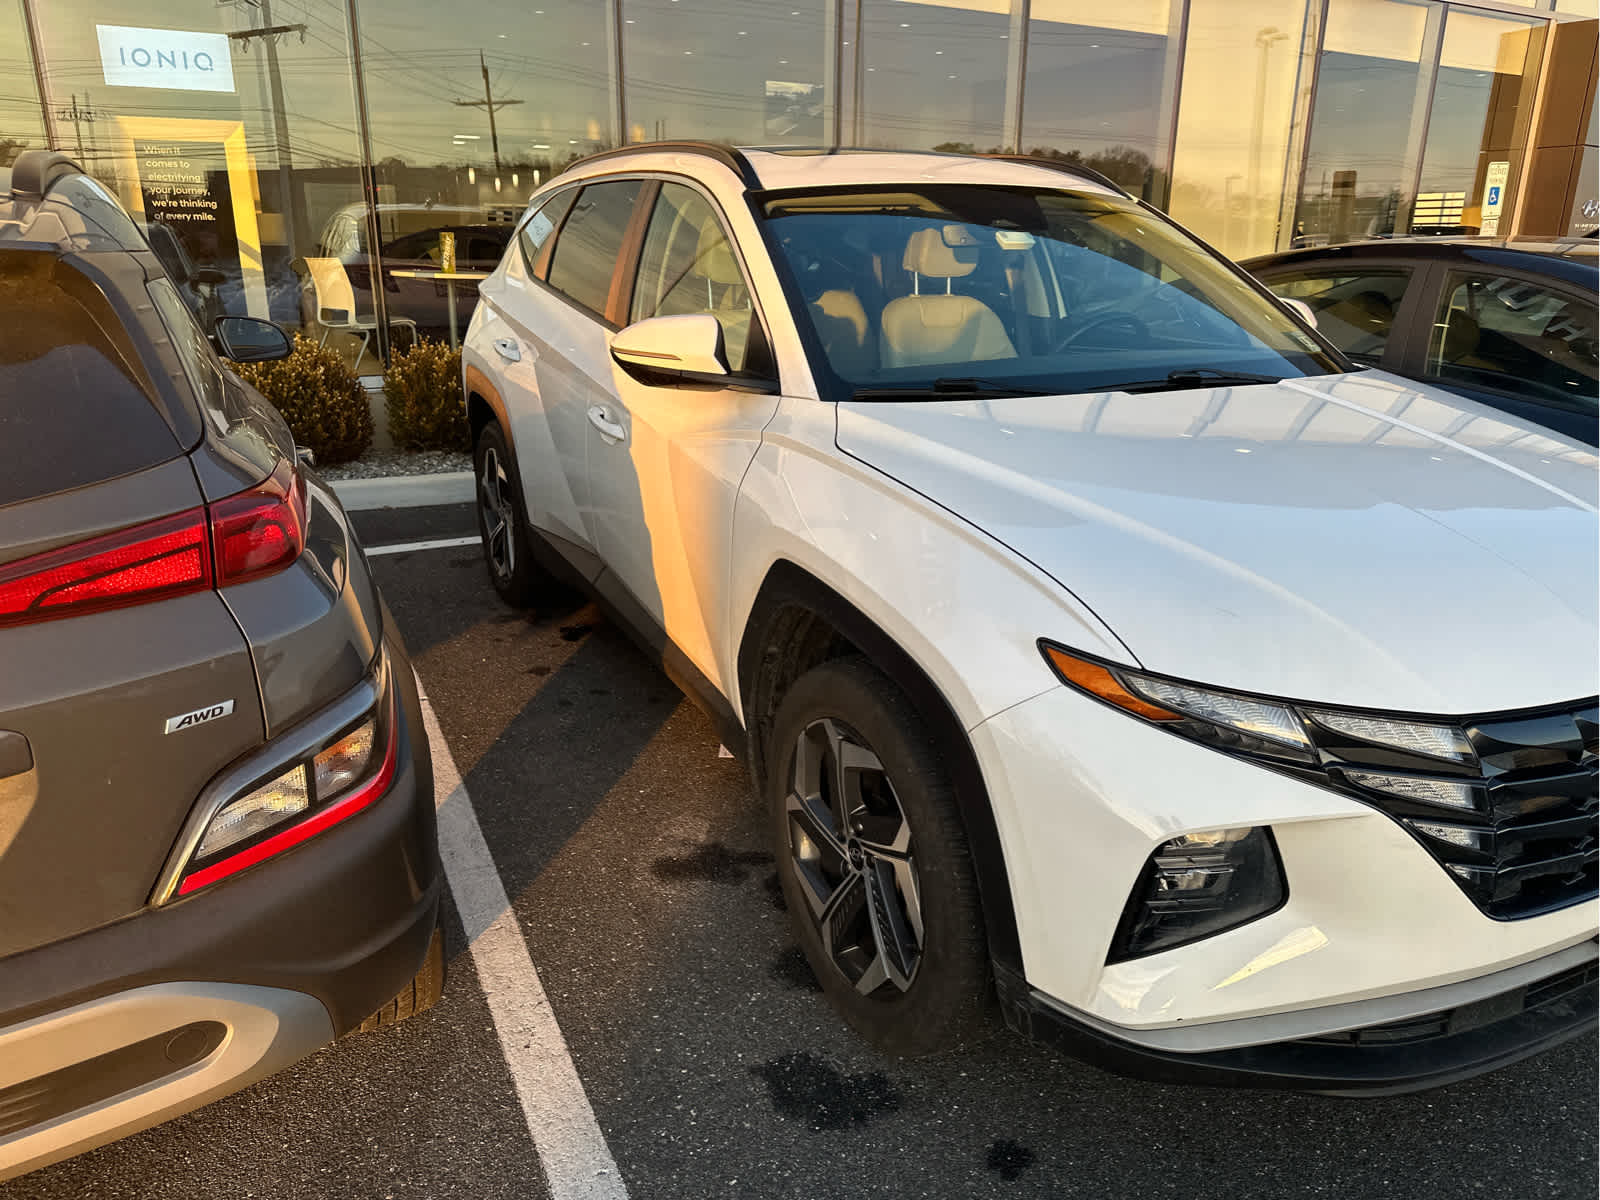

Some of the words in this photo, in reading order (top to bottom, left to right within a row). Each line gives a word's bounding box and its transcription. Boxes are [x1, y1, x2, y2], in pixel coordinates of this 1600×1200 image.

[119, 47, 214, 72] IONIQ
[143, 144, 172, 154] When
[145, 160, 178, 168] comes
[180, 160, 191, 168] to
[148, 172, 201, 183] electrifying
[150, 187, 172, 195] your
[173, 185, 211, 196] journey,
[152, 199, 178, 207] we're
[180, 199, 218, 210] thinking
[154, 211, 164, 220] of
[166, 213, 192, 221] every
[193, 212, 216, 221] mile.
[175, 706, 224, 729] AWD
